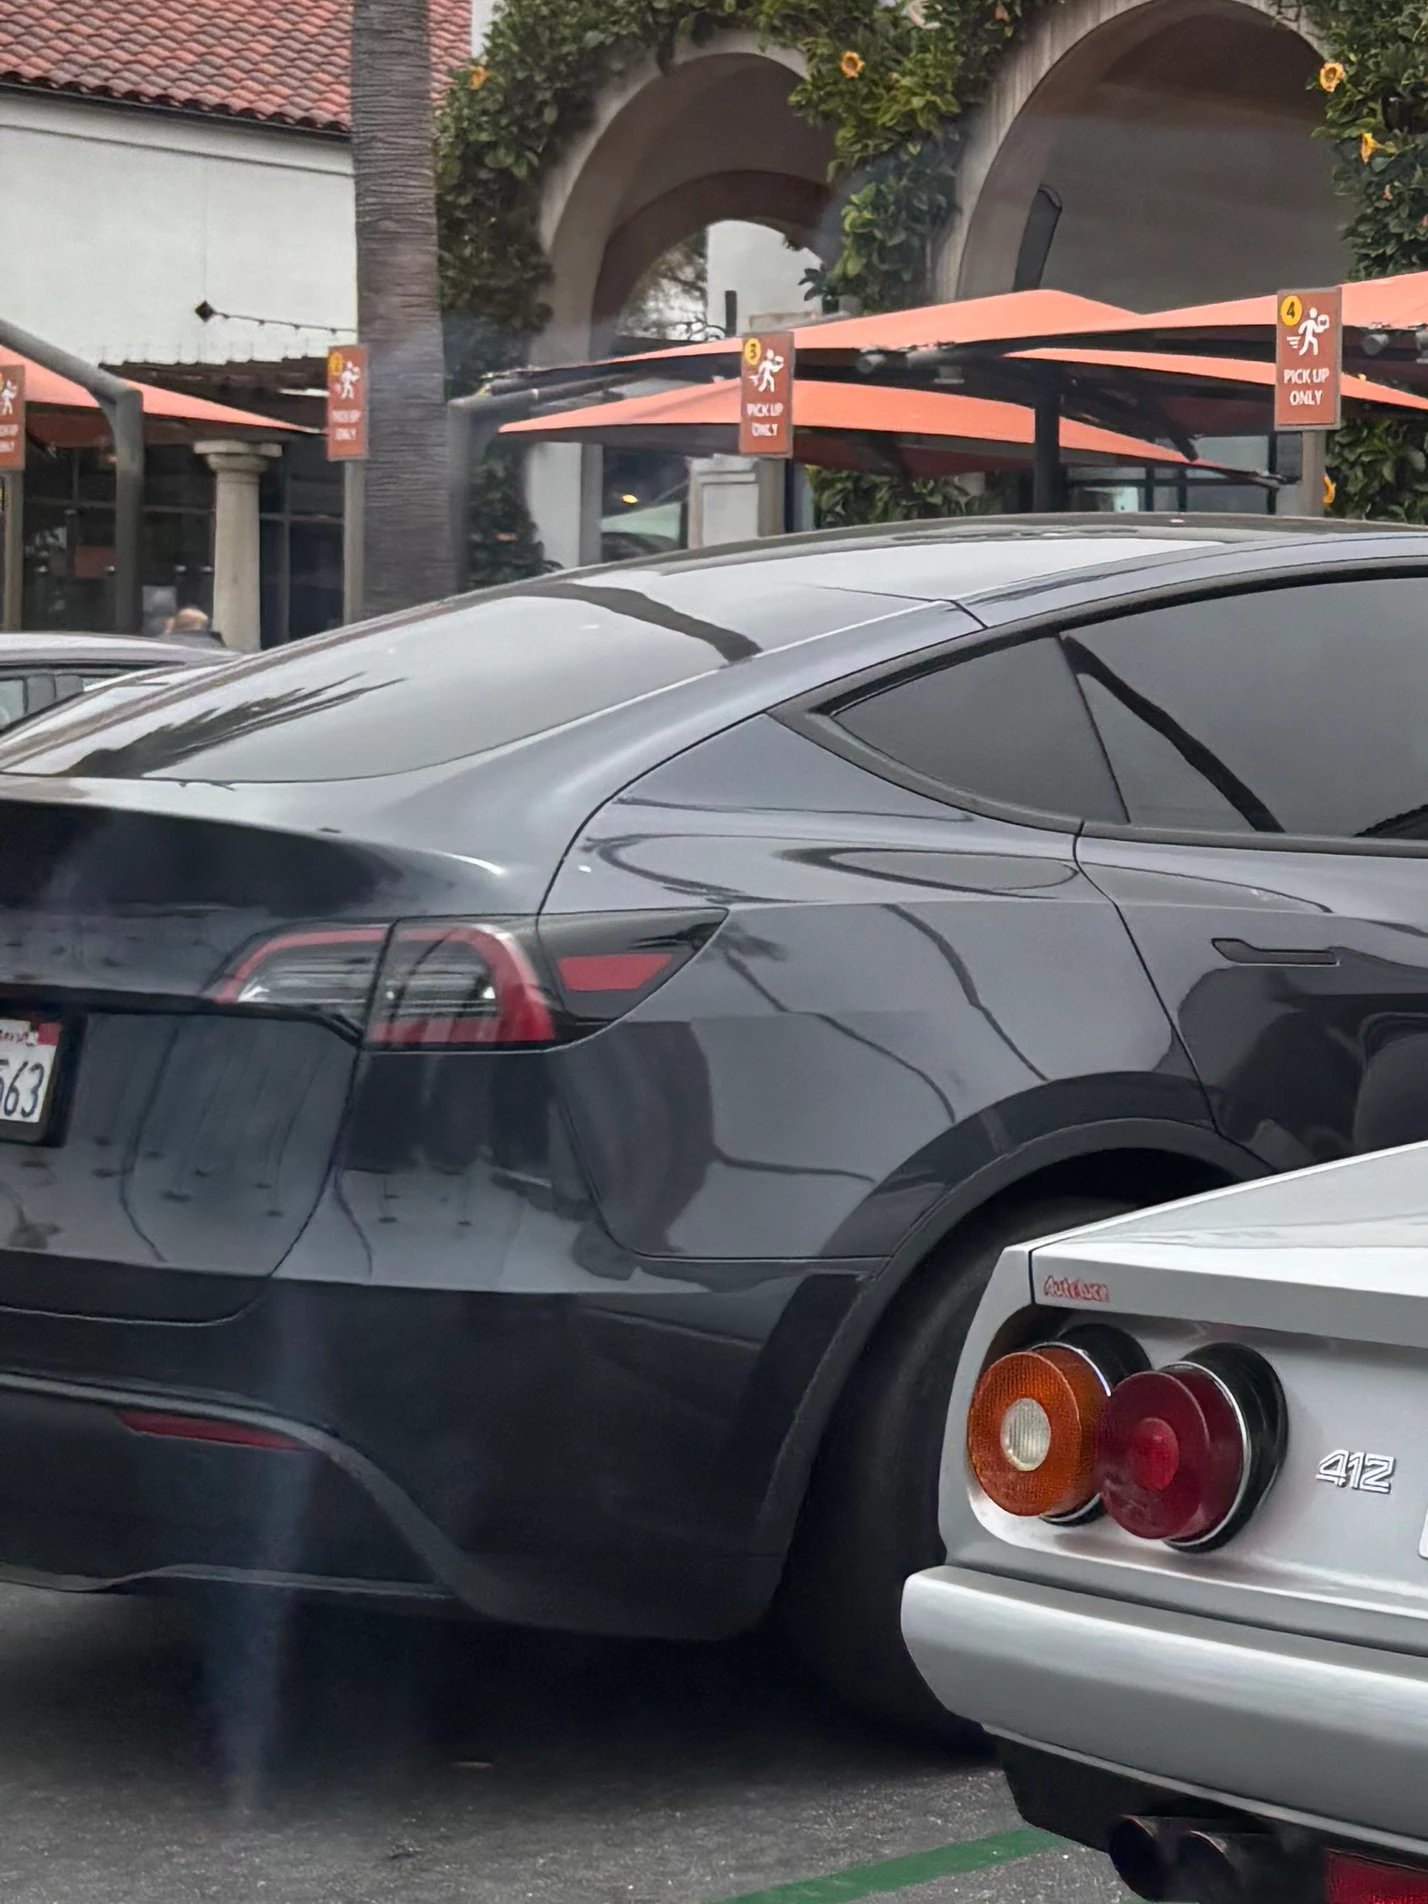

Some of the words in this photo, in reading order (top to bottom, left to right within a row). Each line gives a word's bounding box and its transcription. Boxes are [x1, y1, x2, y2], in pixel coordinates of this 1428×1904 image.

[1286, 301, 1296, 318] 4
[750, 343, 758, 360] 3
[1289, 390, 1323, 405] ONLY
[0, 1059, 45, 1118] 63
[1316, 1449, 1396, 1494] 412
